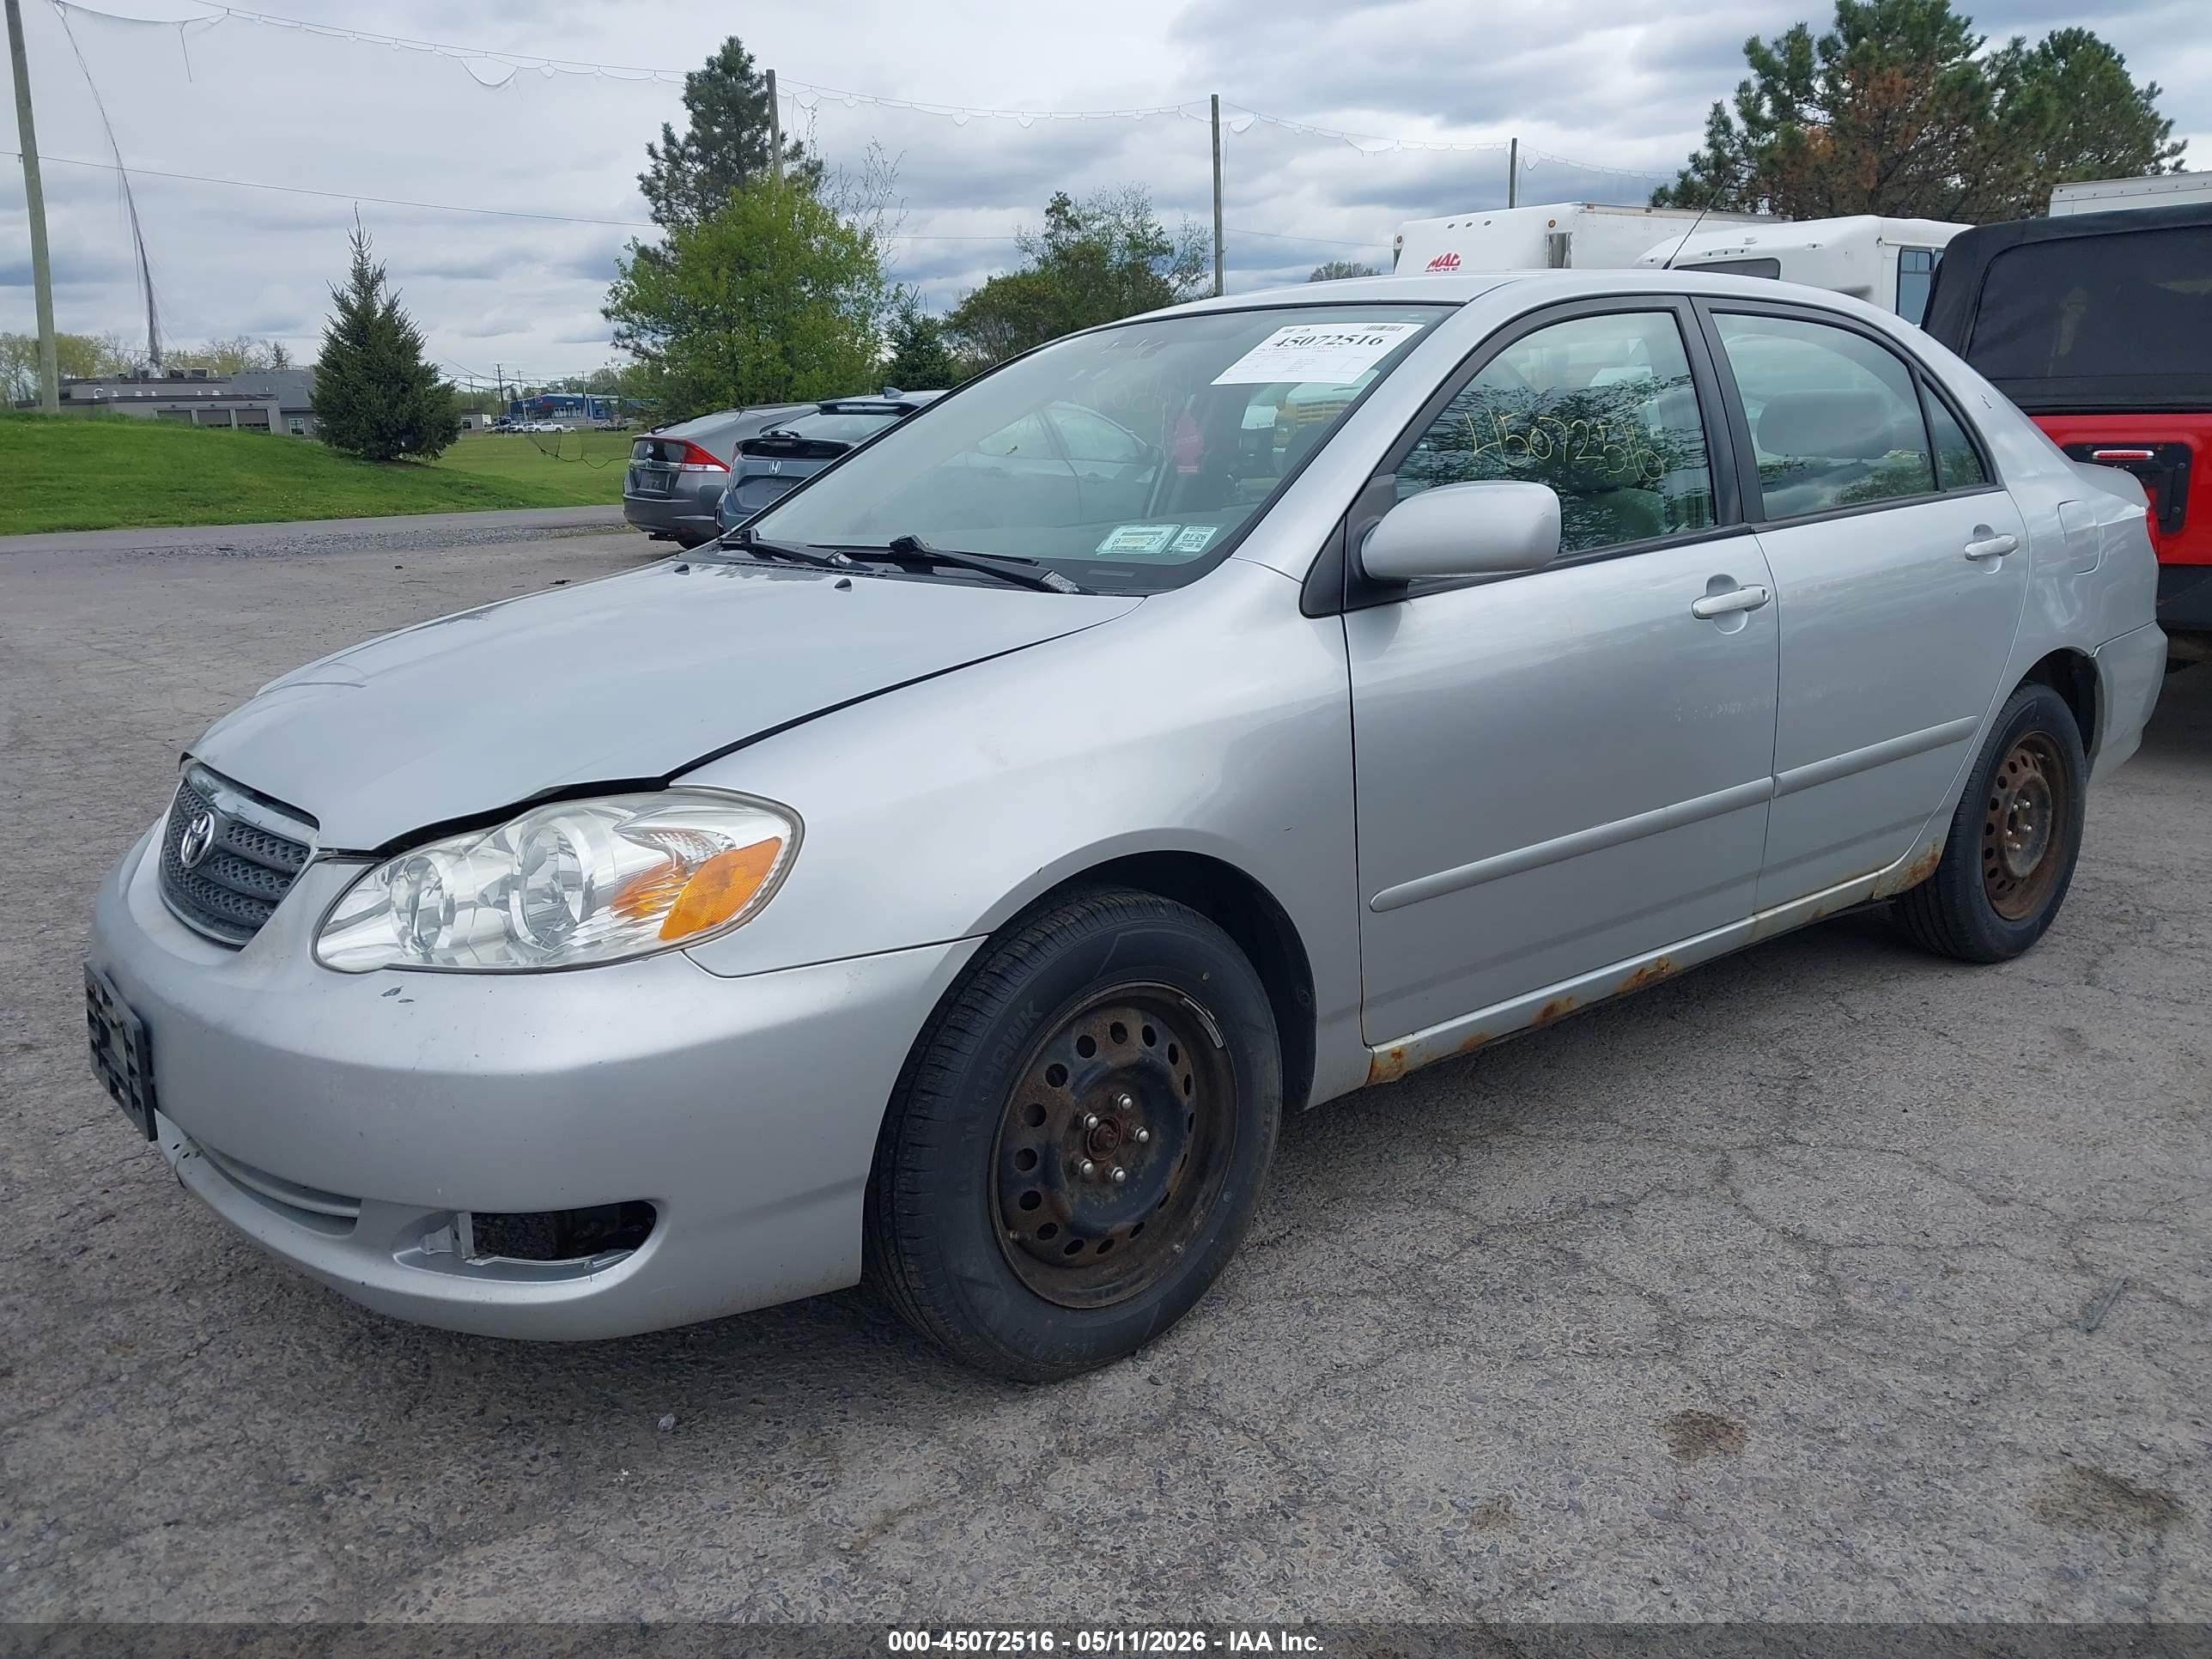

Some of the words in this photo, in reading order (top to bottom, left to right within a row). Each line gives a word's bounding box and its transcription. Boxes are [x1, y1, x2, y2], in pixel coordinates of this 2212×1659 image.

[1425, 252, 1461, 269] MAC
[1273, 333, 1388, 348] 45072516
[1465, 409, 1664, 481] 45072516
[1146, 537, 1165, 545] 27
